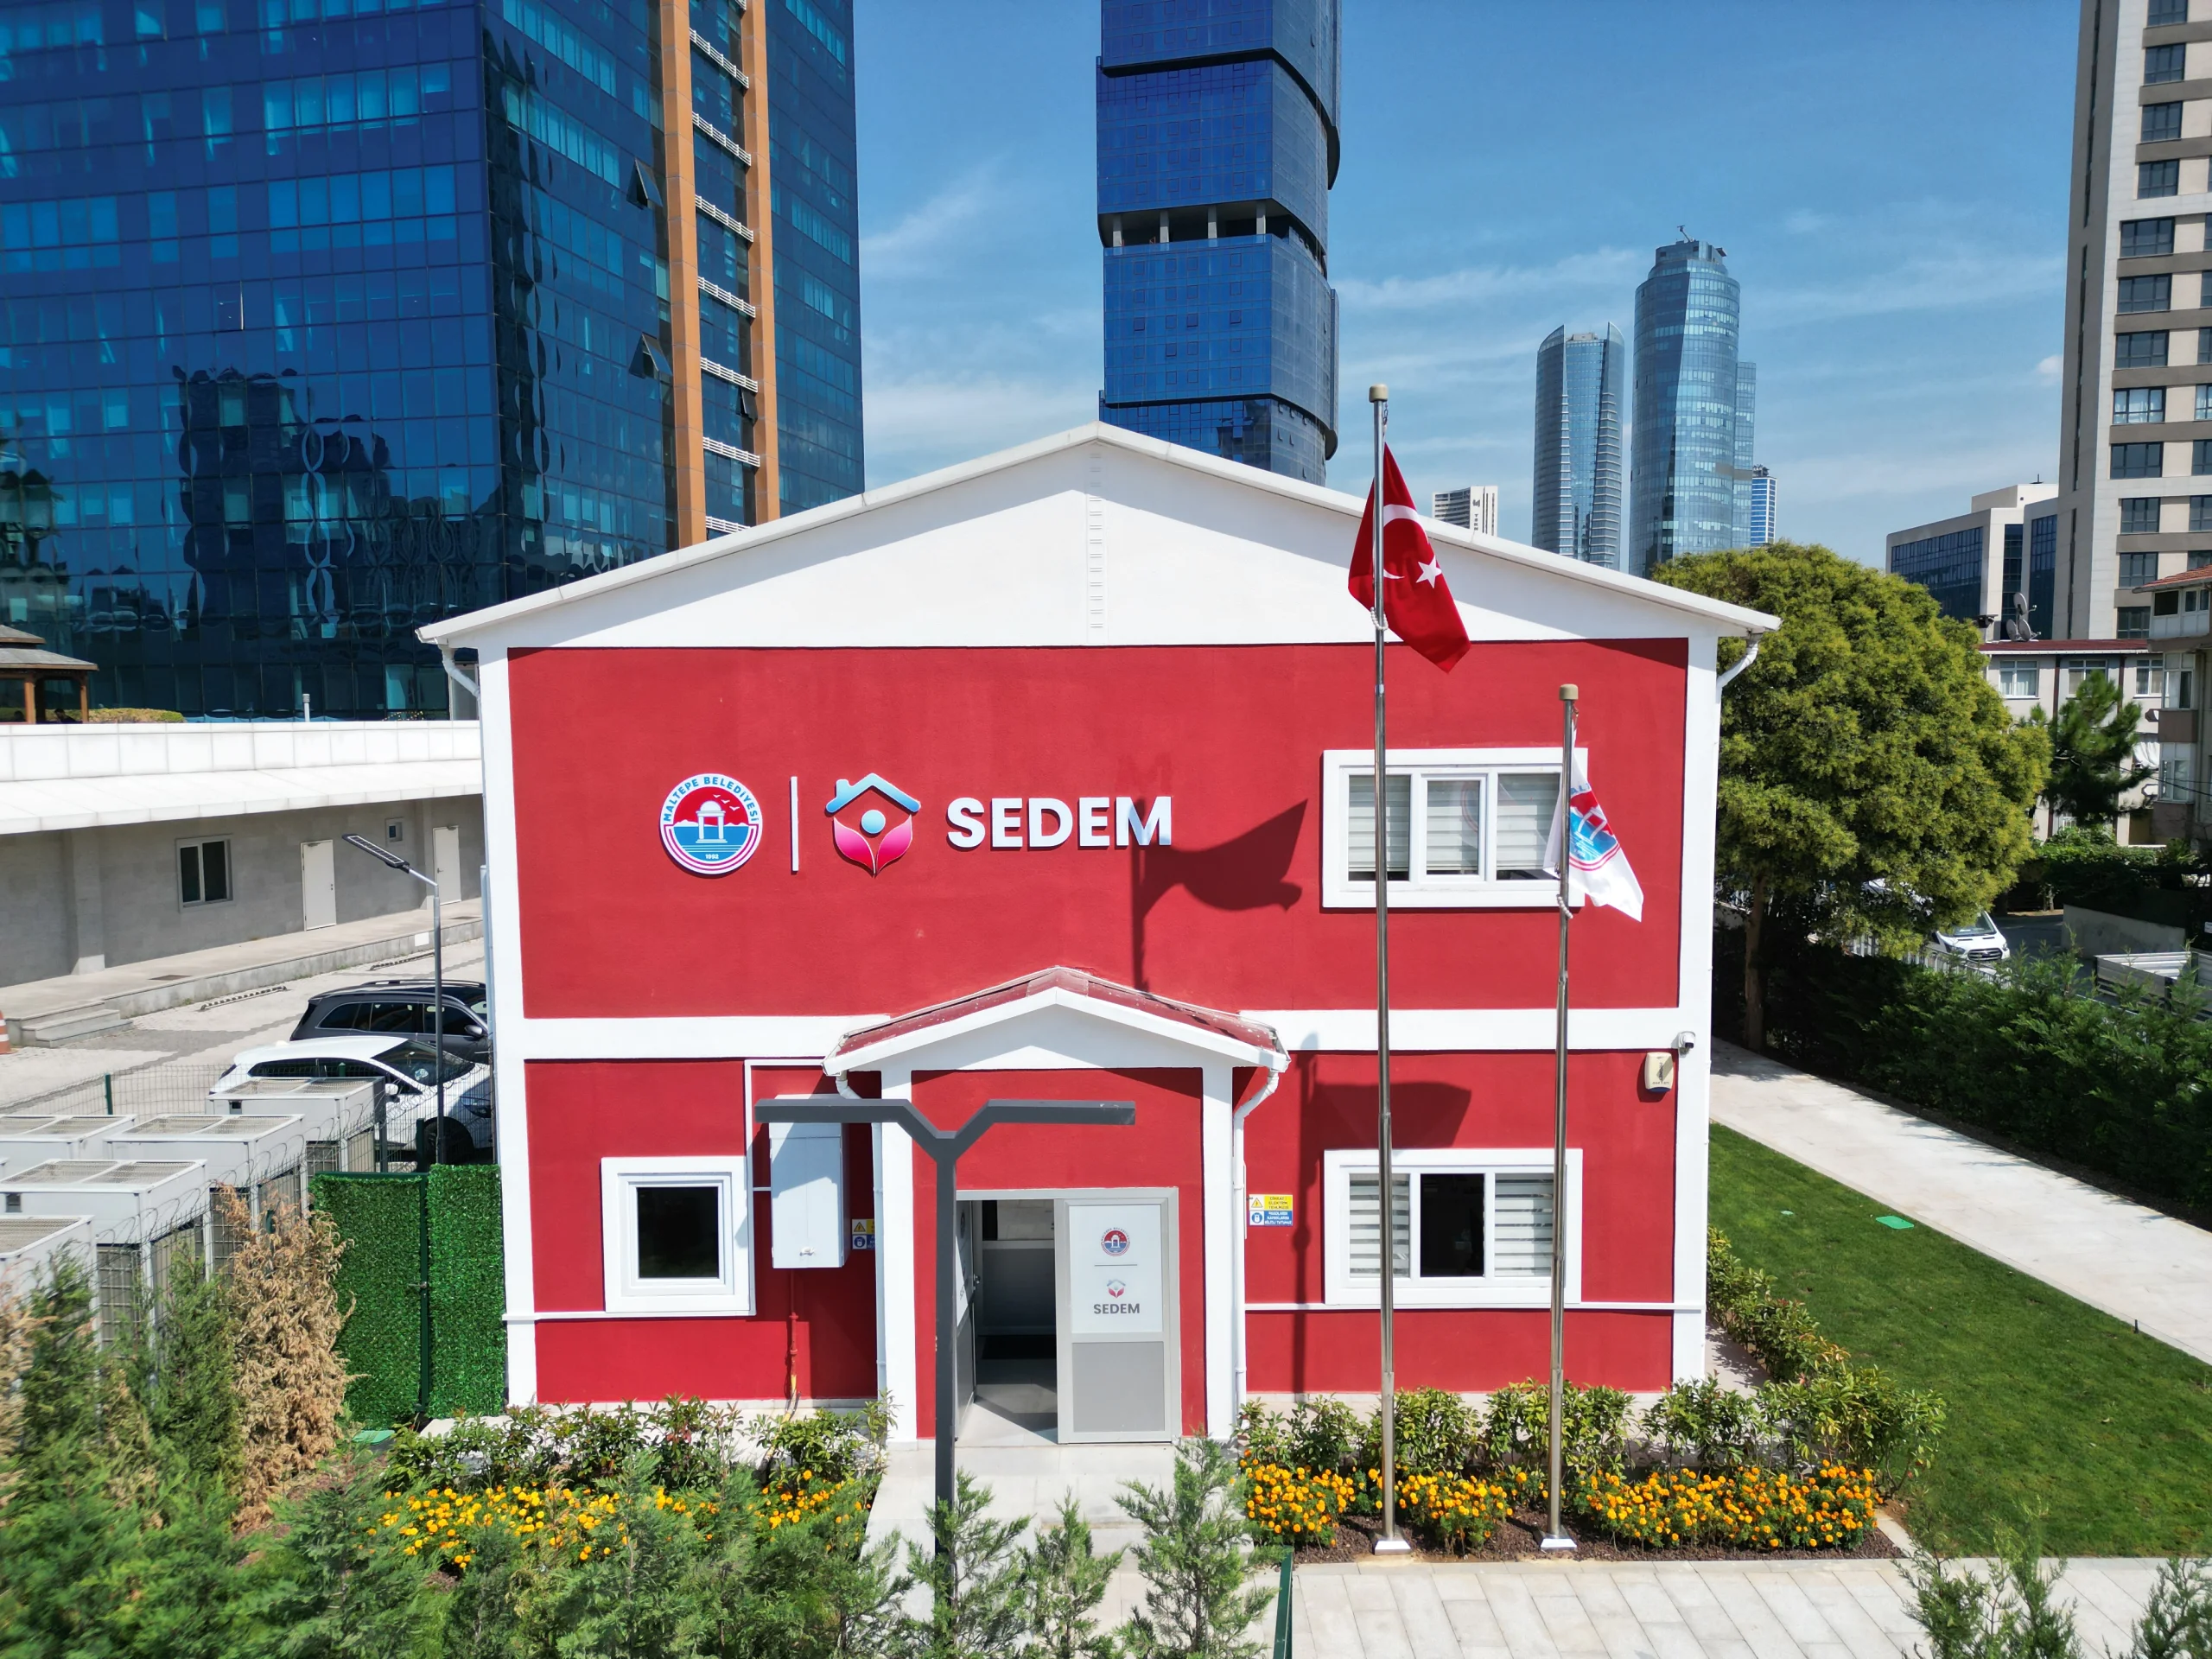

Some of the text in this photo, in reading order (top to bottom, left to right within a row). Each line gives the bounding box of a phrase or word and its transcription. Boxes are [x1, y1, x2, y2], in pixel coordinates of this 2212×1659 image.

[664, 779, 699, 822] MALTEPE
[947, 796, 1172, 849] SEDEM
[1093, 1303, 1141, 1314] SEDEM
